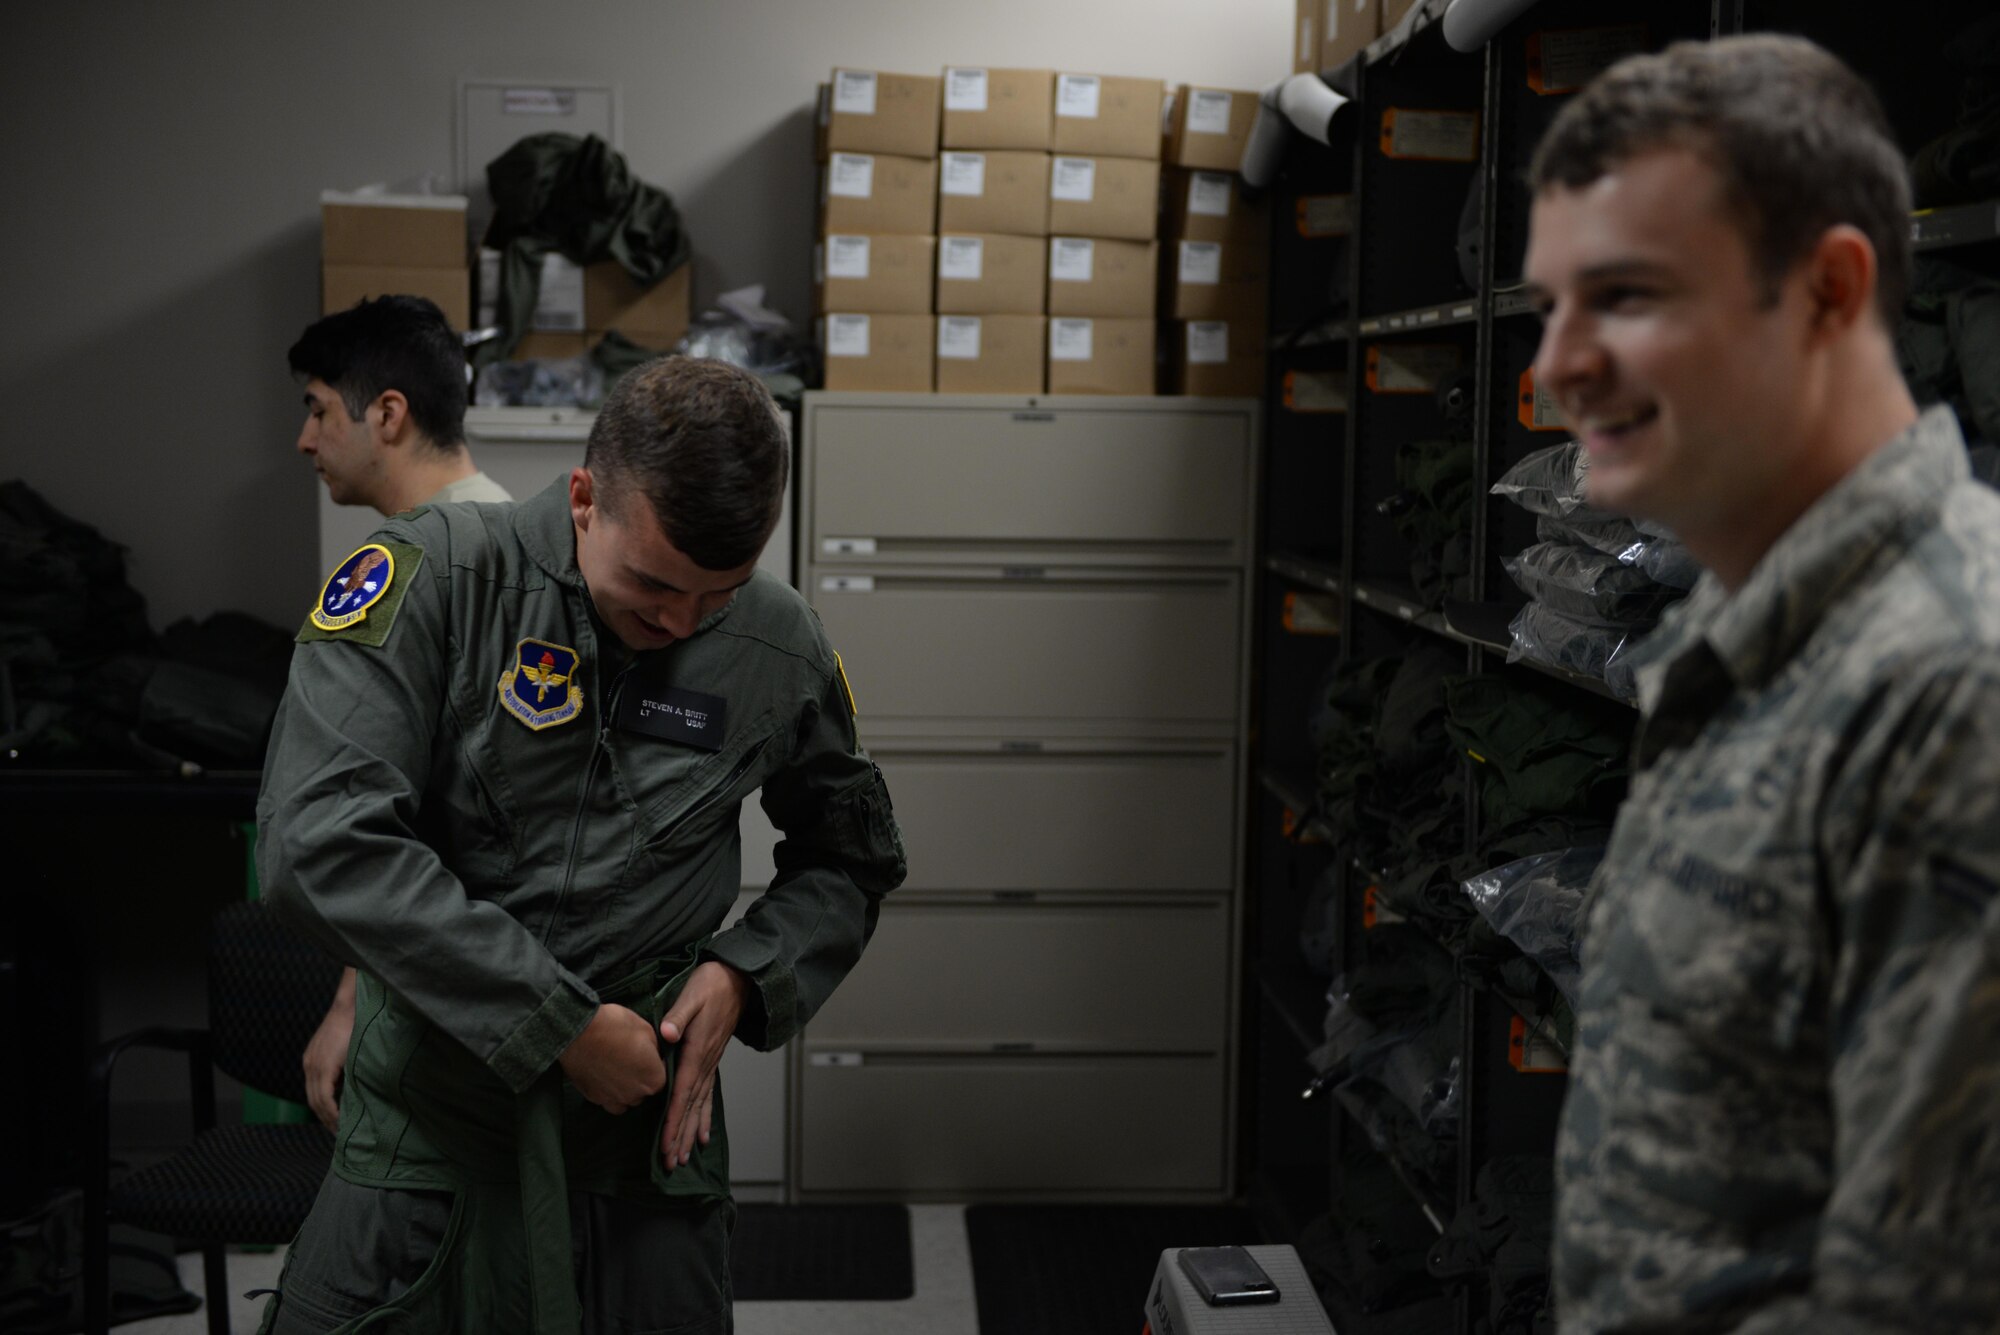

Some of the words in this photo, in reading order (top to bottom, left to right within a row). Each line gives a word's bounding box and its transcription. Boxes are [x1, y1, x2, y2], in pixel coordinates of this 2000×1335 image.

[640, 709, 651, 717] LT
[686, 718, 707, 730] USAF
[642, 699, 673, 713] STEVEN
[675, 707, 683, 716] A.
[685, 708, 708, 721] BRITT
